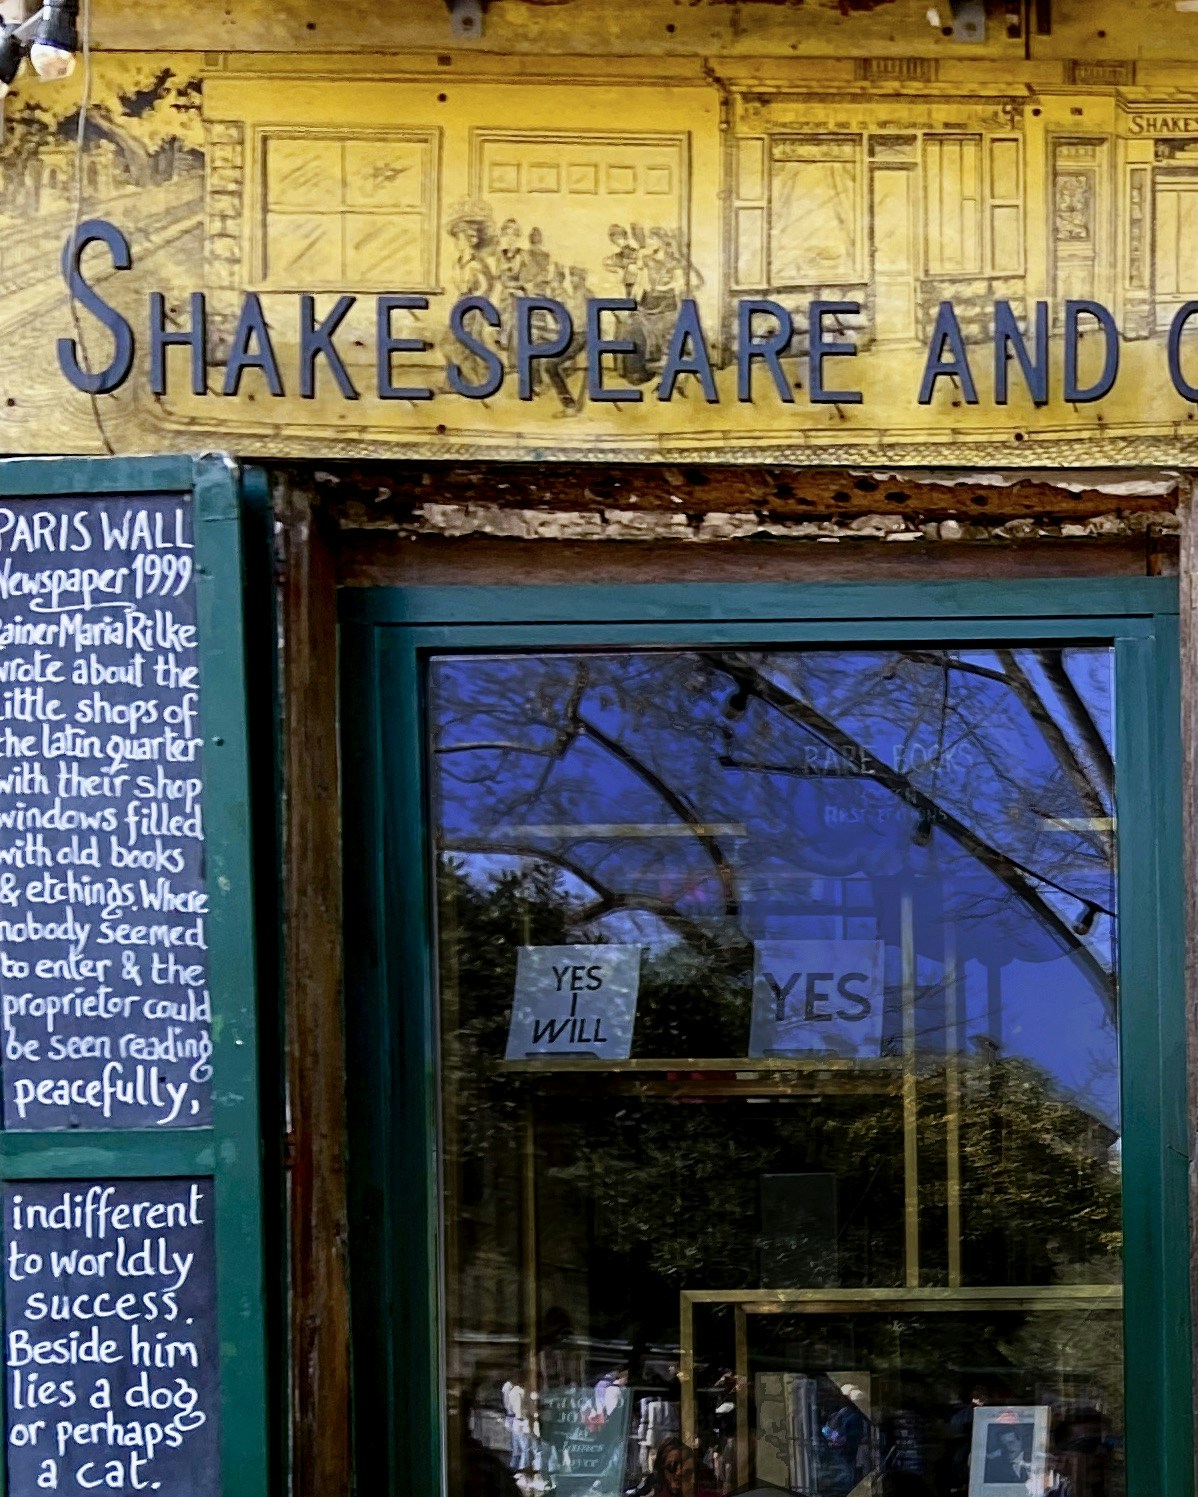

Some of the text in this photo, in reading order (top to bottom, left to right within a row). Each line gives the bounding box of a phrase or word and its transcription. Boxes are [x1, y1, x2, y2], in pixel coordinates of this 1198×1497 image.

[56, 218, 864, 406] SHAKESPEARE
[917, 300, 1120, 405] AND
[0, 508, 195, 553] PARIS WALL
[132, 553, 193, 600] 1999
[0, 609, 199, 653] ainer Maria Rilke
[72, 652, 146, 688] about
[153, 652, 200, 689] the
[0, 686, 199, 739] ittle shops of
[42, 722, 105, 759] latin
[100, 725, 205, 775] quarter
[0, 760, 203, 814] with their shop
[0, 797, 205, 847] windows filled
[0, 832, 54, 868] with
[110, 834, 186, 873] books
[0, 872, 22, 907] &
[139, 876, 211, 914] Where
[0, 905, 209, 953] nobody seemed
[0, 945, 206, 987] to enter & the
[551, 965, 603, 993] YES
[2, 983, 213, 1033] proprietor could
[570, 992, 579, 1018] I
[762, 972, 873, 1022] YES
[6, 1025, 214, 1083] be seen reading
[530, 1017, 608, 1045] WILL
[13, 1061, 201, 1125] peacefully,
[13, 1183, 205, 1239] indifferent
[8, 1236, 194, 1293] to worldly
[23, 1291, 195, 1326] success.
[6, 1324, 199, 1368] Beside him
[12, 1369, 207, 1432] lies a dog
[9, 1410, 185, 1460] or perhaps
[37, 1450, 162, 1490] a cat.
